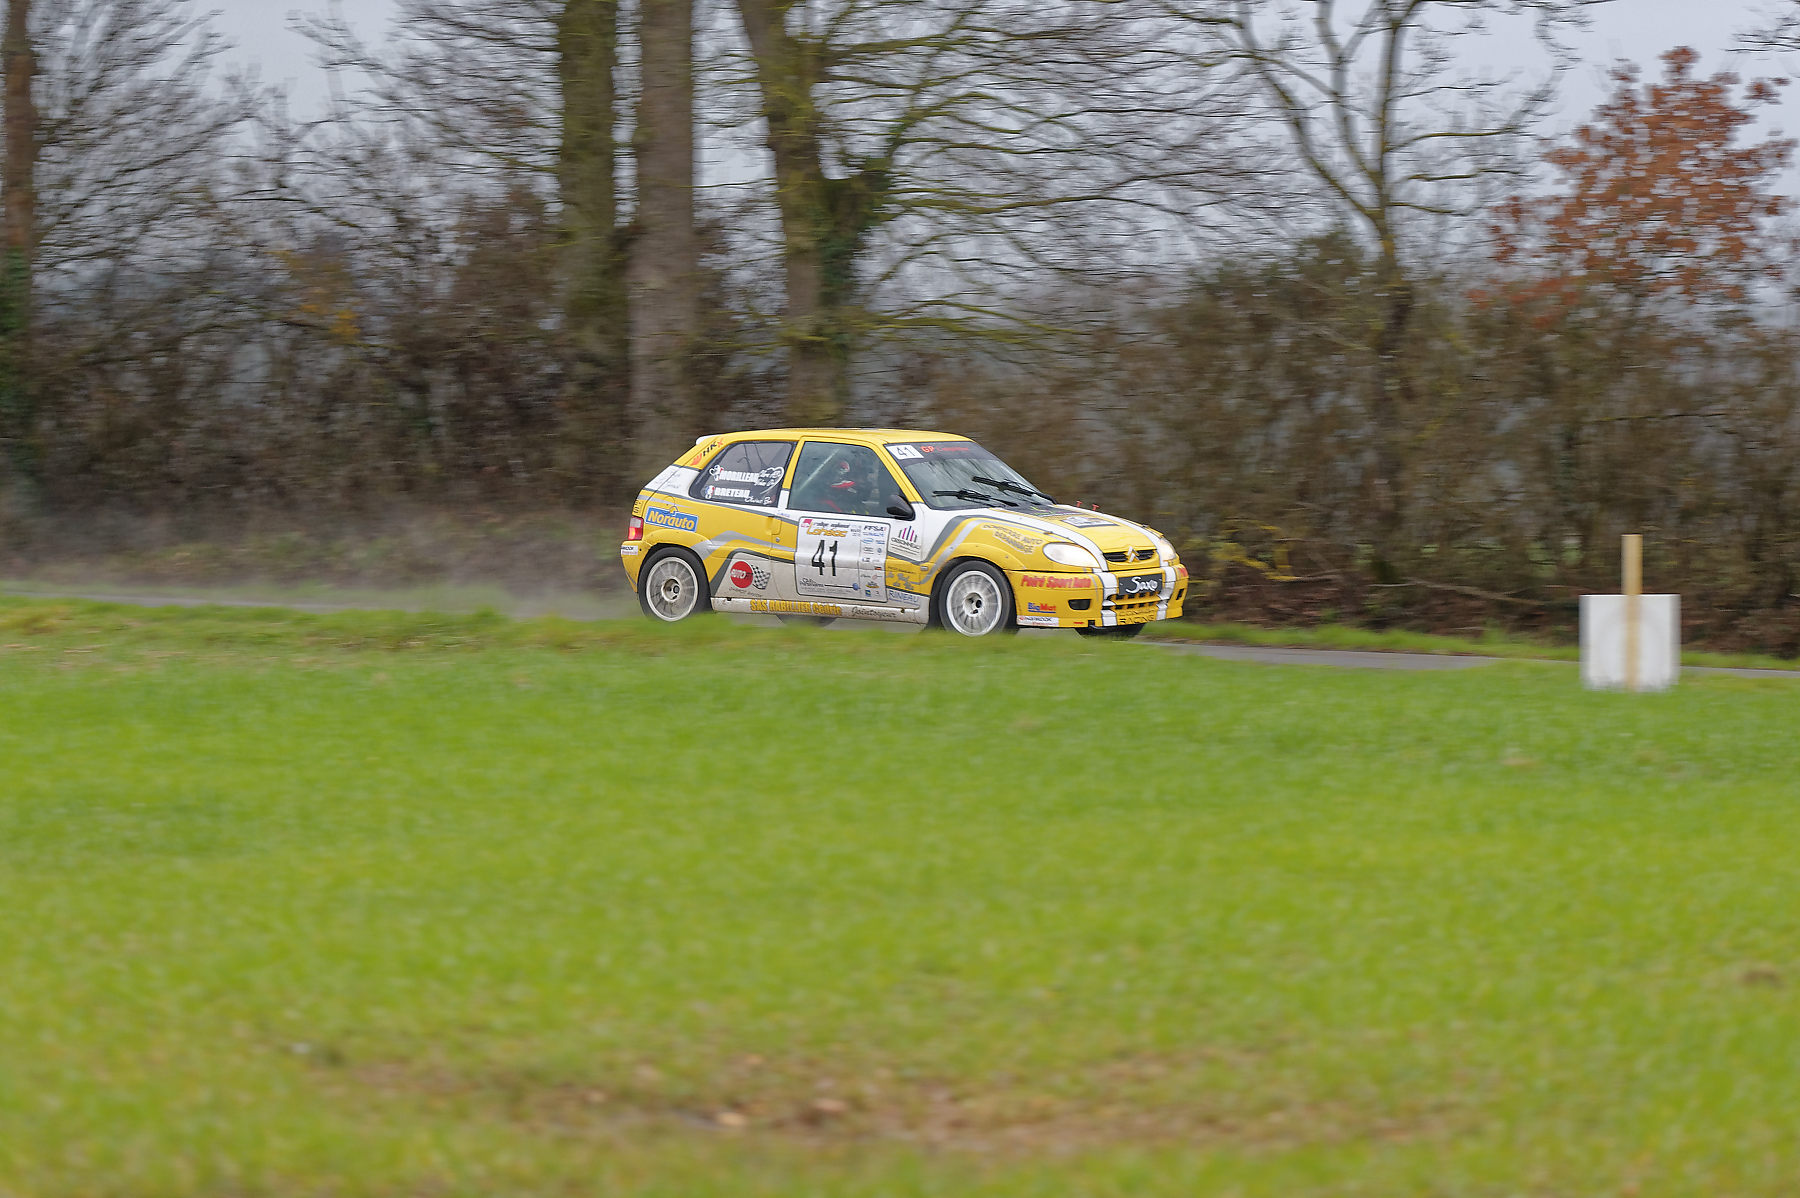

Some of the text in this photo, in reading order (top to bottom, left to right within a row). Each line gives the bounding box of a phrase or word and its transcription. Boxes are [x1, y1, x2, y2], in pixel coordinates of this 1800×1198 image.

[896, 446, 916, 457] 41
[648, 510, 695, 531] Norauto
[811, 540, 838, 577] 41
[1125, 576, 1158, 594] Saxo
[750, 599, 768, 611] SAS
